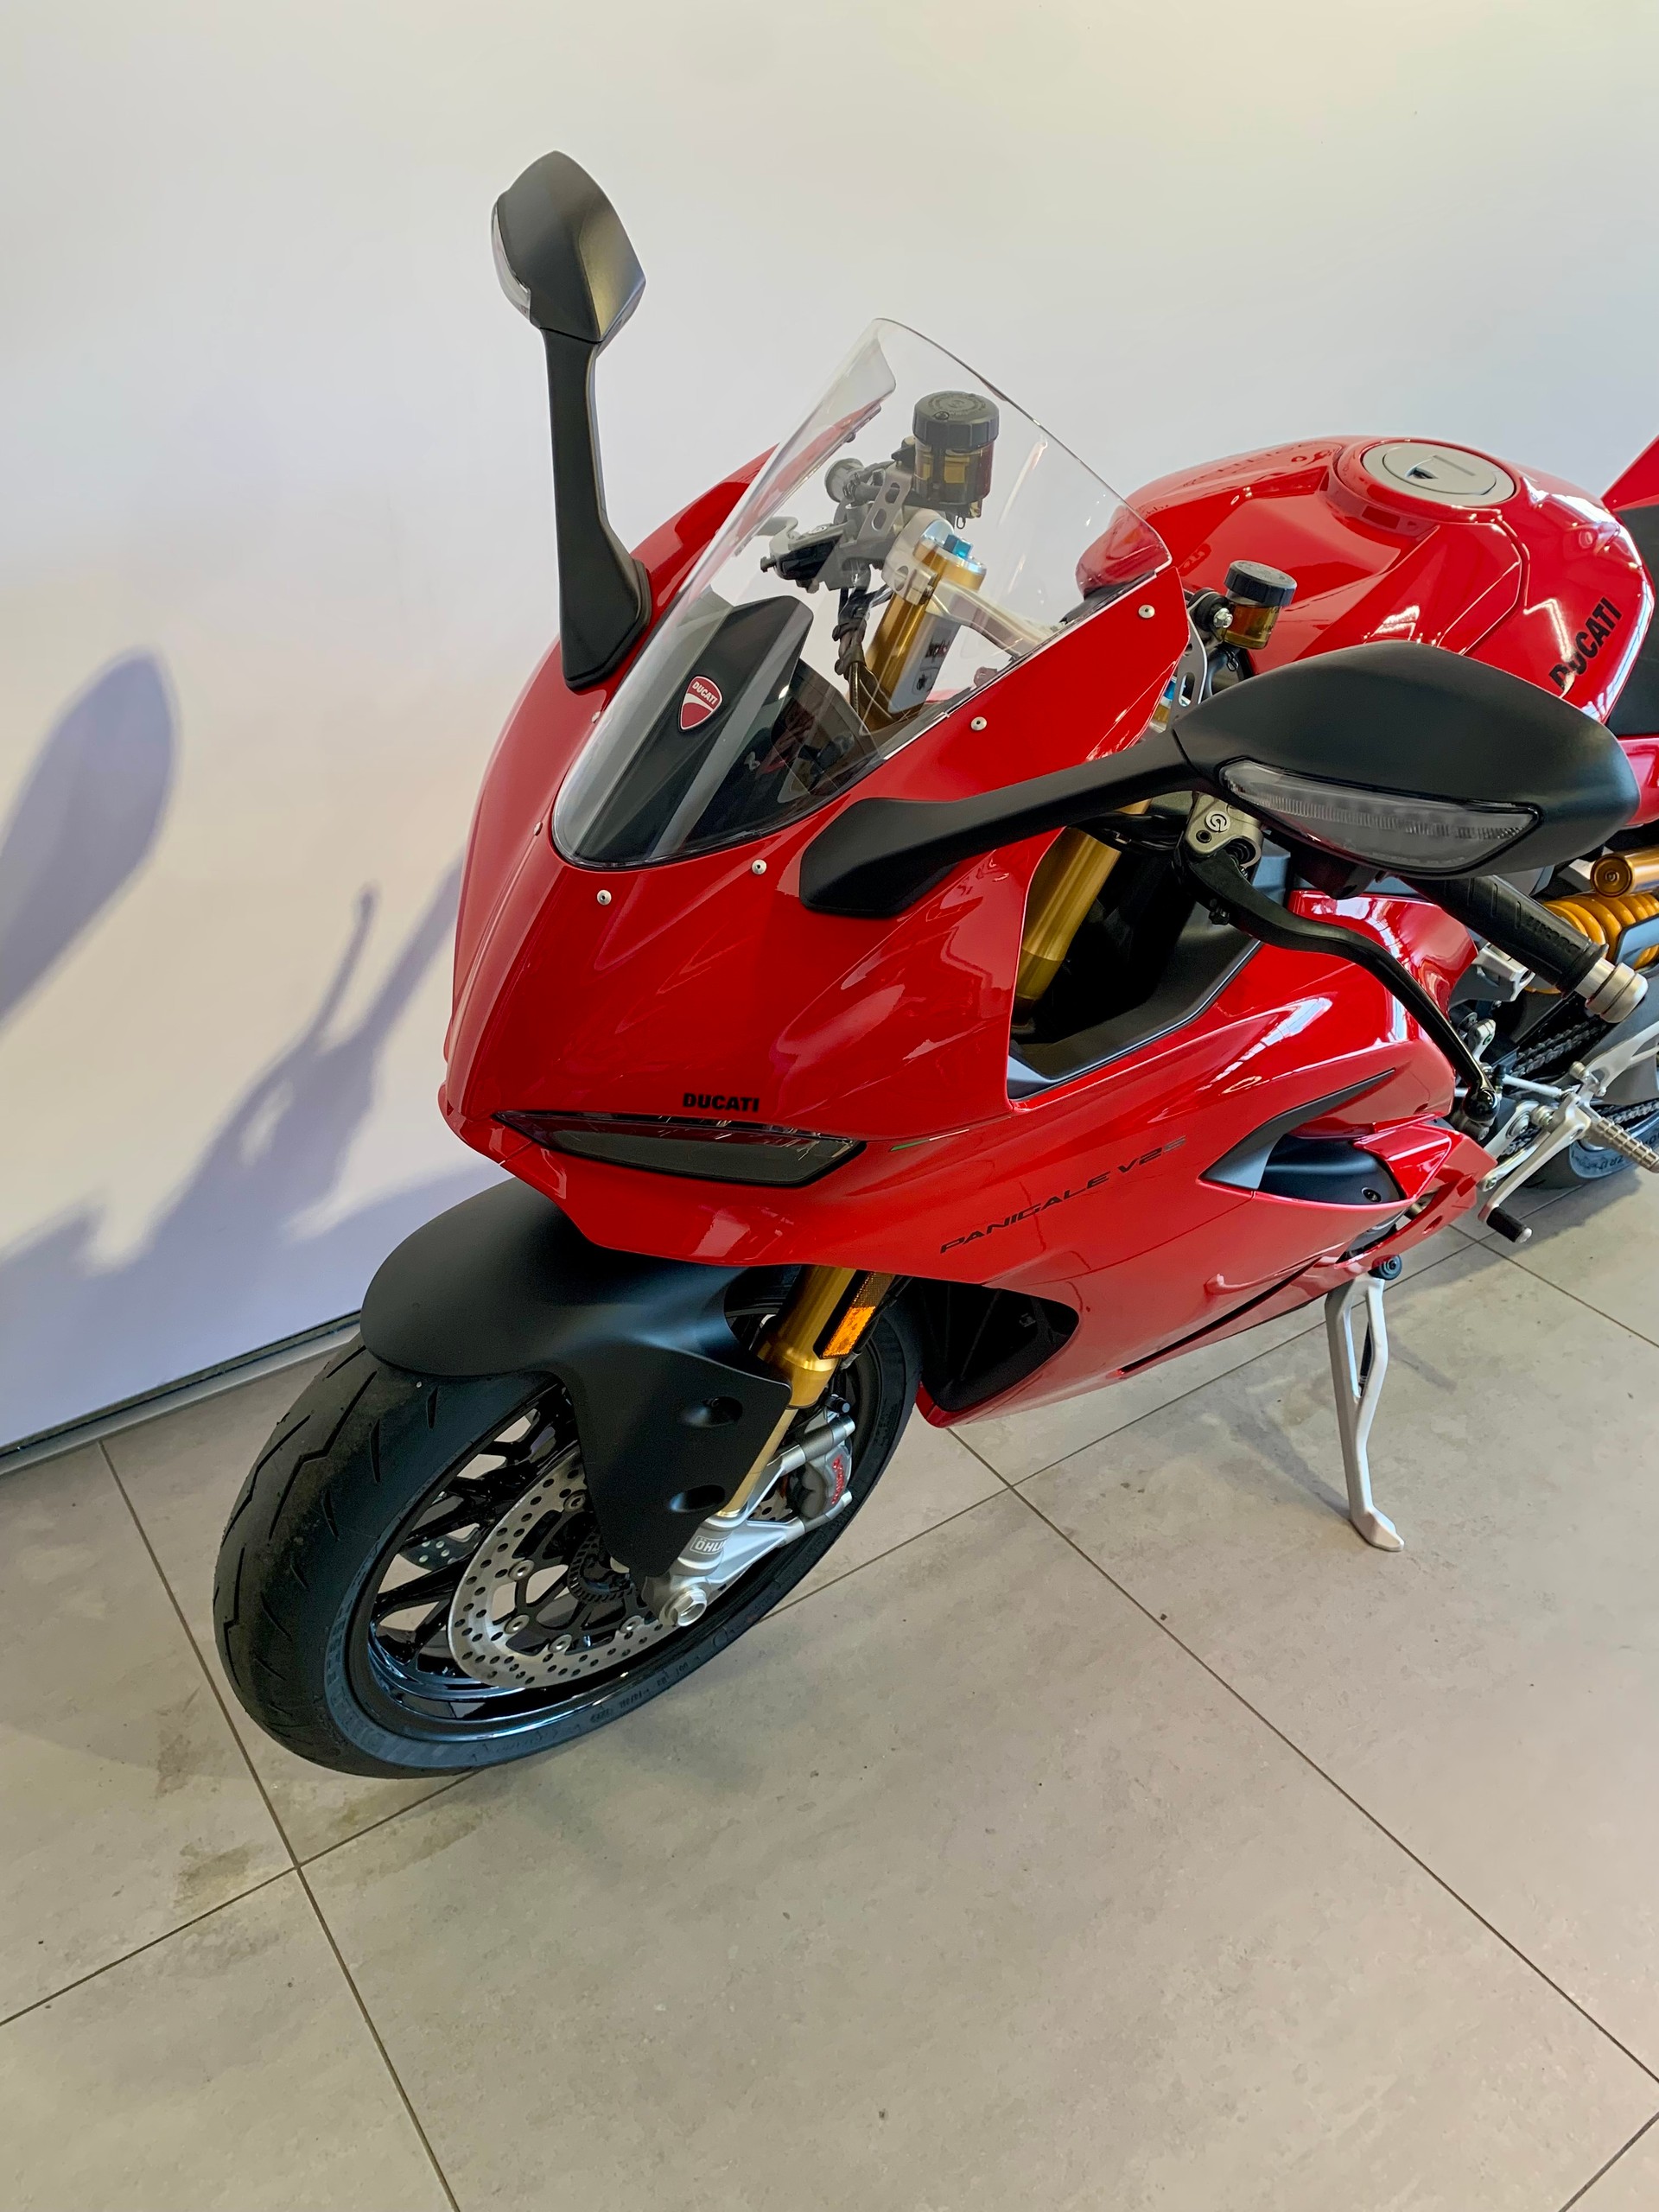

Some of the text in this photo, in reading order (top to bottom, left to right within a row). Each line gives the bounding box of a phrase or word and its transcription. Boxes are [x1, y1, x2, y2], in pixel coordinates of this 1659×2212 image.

[1548, 597, 1622, 691] DUCATI
[692, 681, 718, 705] DUCATI
[683, 1092, 760, 1112] DUCATI
[940, 1171, 1110, 1254] PANIGALE
